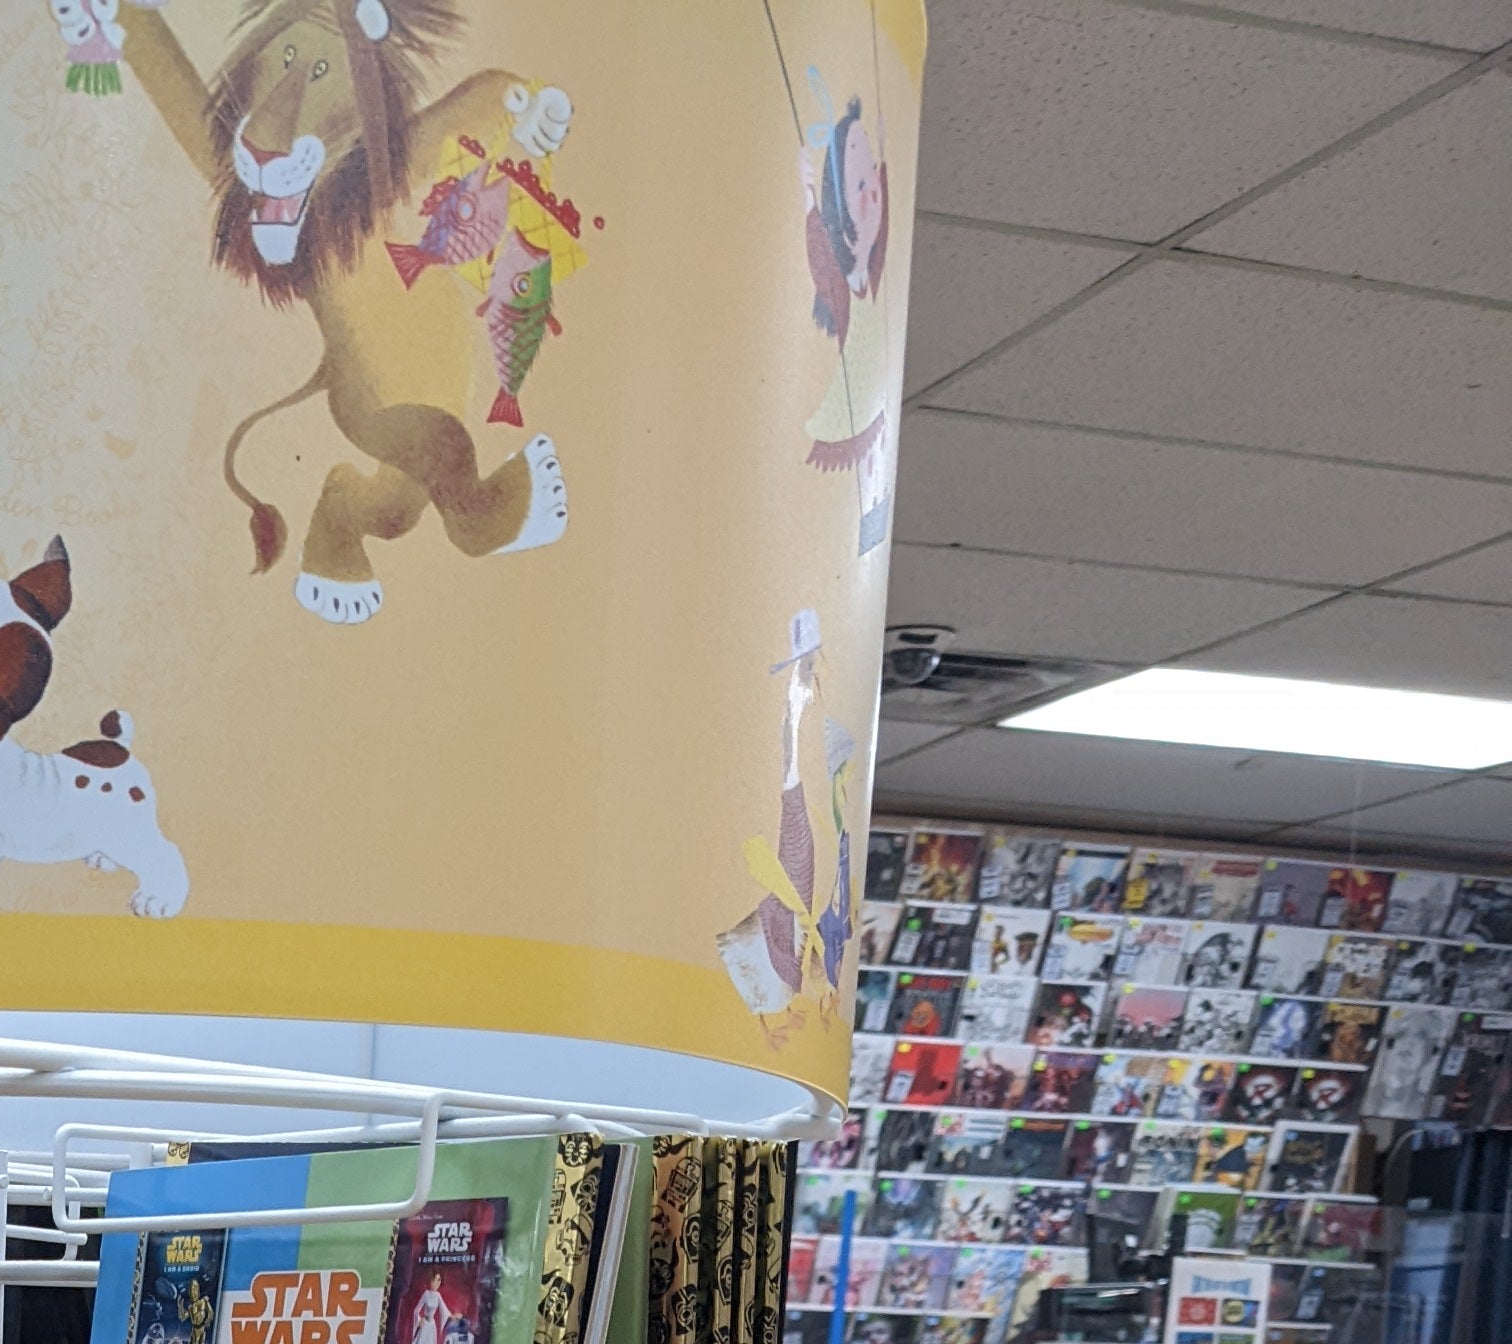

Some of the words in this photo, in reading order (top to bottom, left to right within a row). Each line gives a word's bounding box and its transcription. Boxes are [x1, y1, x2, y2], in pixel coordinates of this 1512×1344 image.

[427, 1222, 473, 1238] STAR
[427, 1237, 472, 1253] WARS
[230, 1269, 369, 1318] STAR
